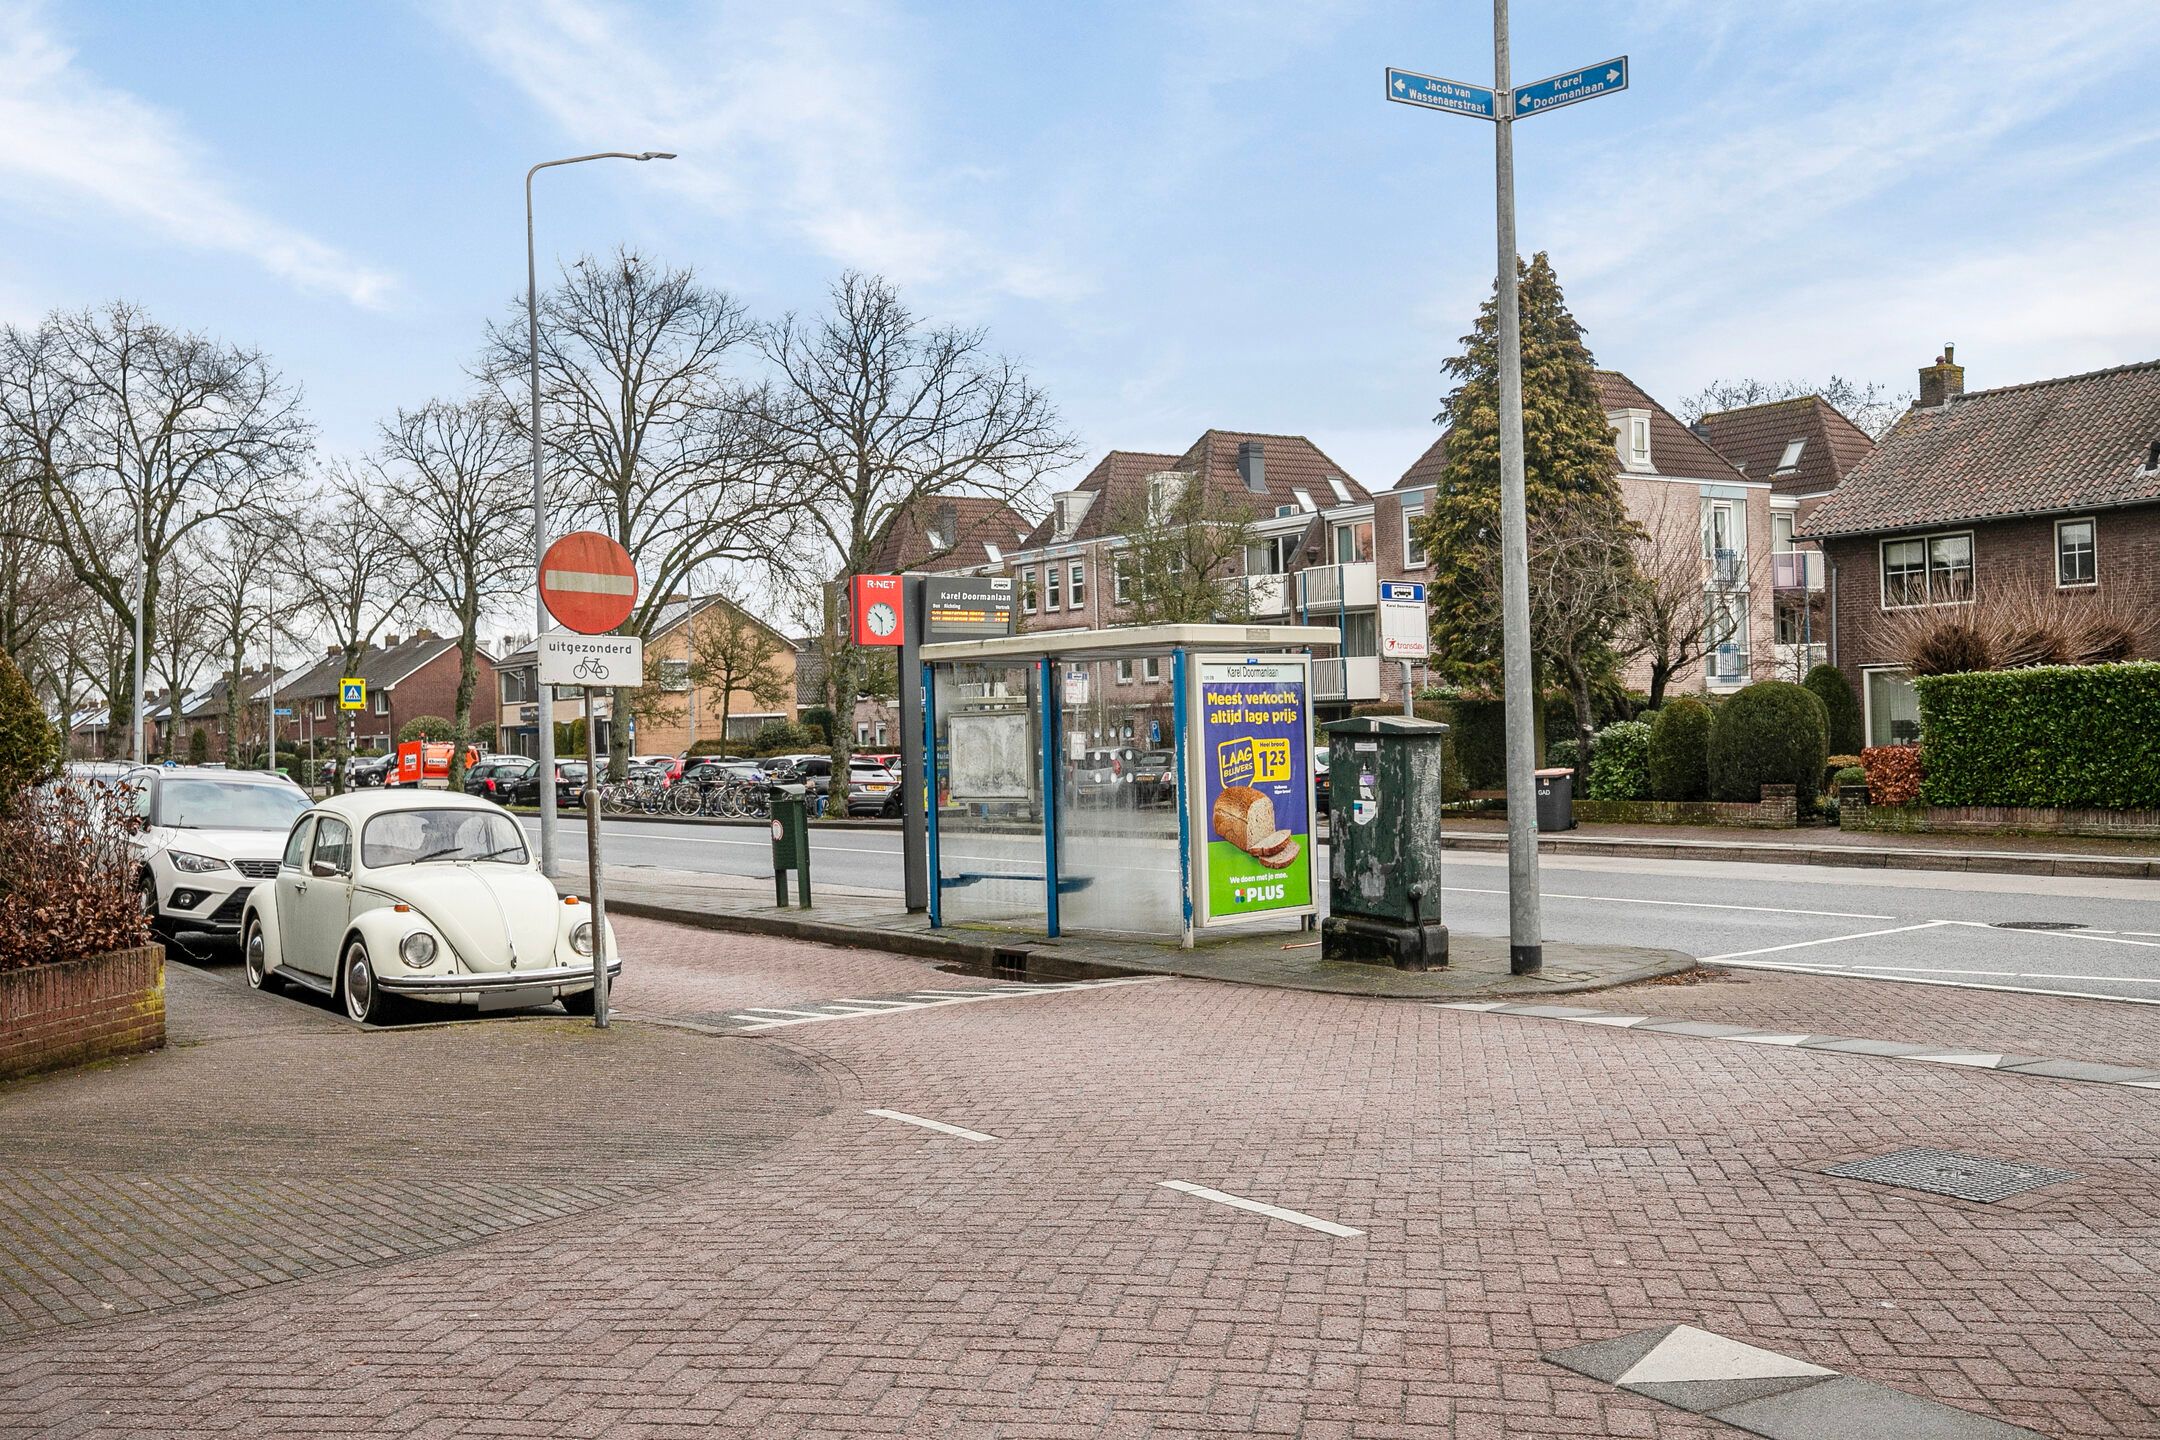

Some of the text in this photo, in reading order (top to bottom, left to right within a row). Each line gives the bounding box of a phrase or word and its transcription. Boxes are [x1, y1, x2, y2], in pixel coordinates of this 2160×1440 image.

[1425, 80, 1471, 99] Jacob van
[1554, 73, 1582, 91] Karel
[1408, 88, 1486, 114] Wassenaerstraat
[1533, 81, 1604, 109] Doormanlaan
[941, 592, 1011, 601] Karel Doormanlaan
[549, 641, 632, 654] uitgezonderd
[1227, 666, 1242, 678] Karel
[1243, 666, 1278, 678] Doormanlaan
[1207, 690, 1299, 706] Meest verkocht,
[1210, 708, 1297, 726] altijd lage prijs
[1222, 746, 1253, 769] LAAG
[1230, 876, 1240, 884] We
[1240, 875, 1256, 883] doen
[1256, 873, 1268, 881] met
[1267, 872, 1274, 881] je
[1246, 884, 1285, 903] PLUS
